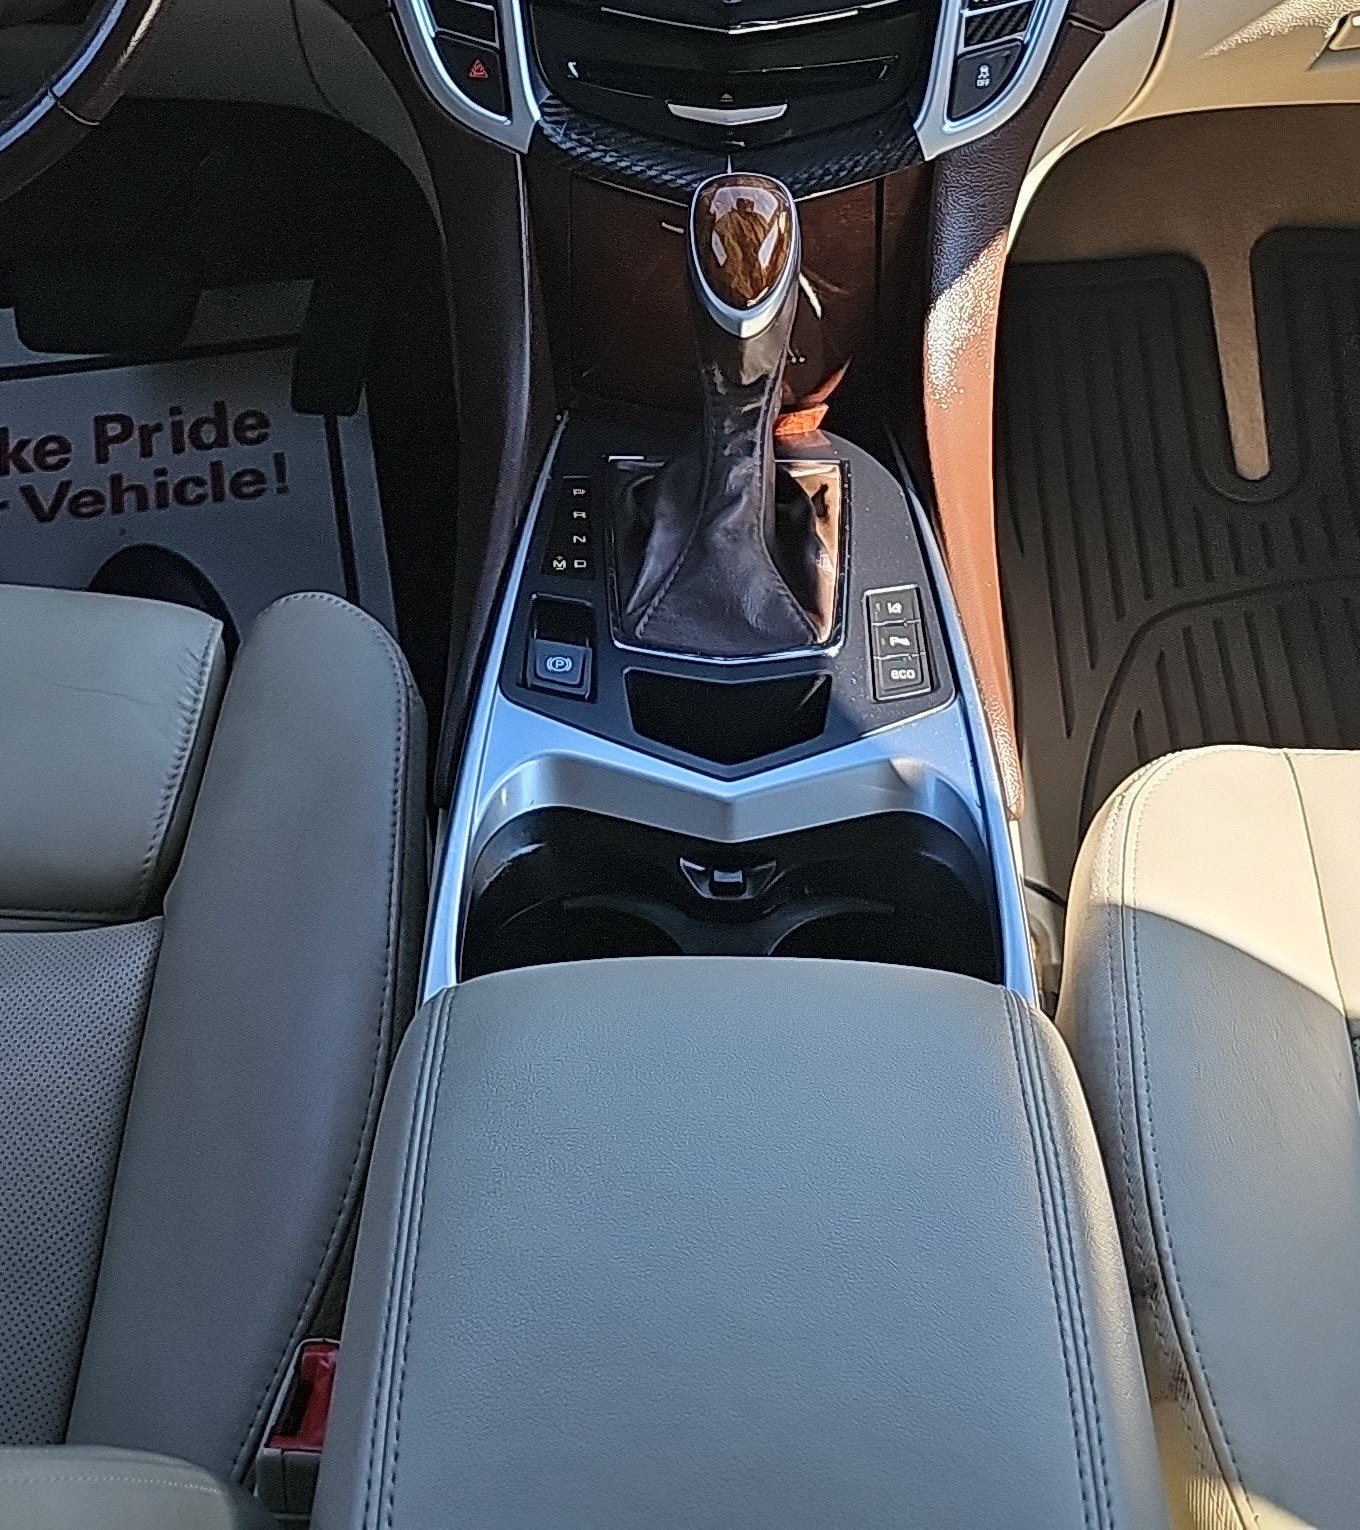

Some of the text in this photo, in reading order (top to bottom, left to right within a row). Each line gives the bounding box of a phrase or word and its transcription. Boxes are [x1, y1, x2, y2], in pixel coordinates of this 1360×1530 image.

[92, 400, 271, 465] Pride
[19, 453, 289, 523] Vehicle!
[572, 535, 587, 543] N
[573, 560, 587, 568] D
